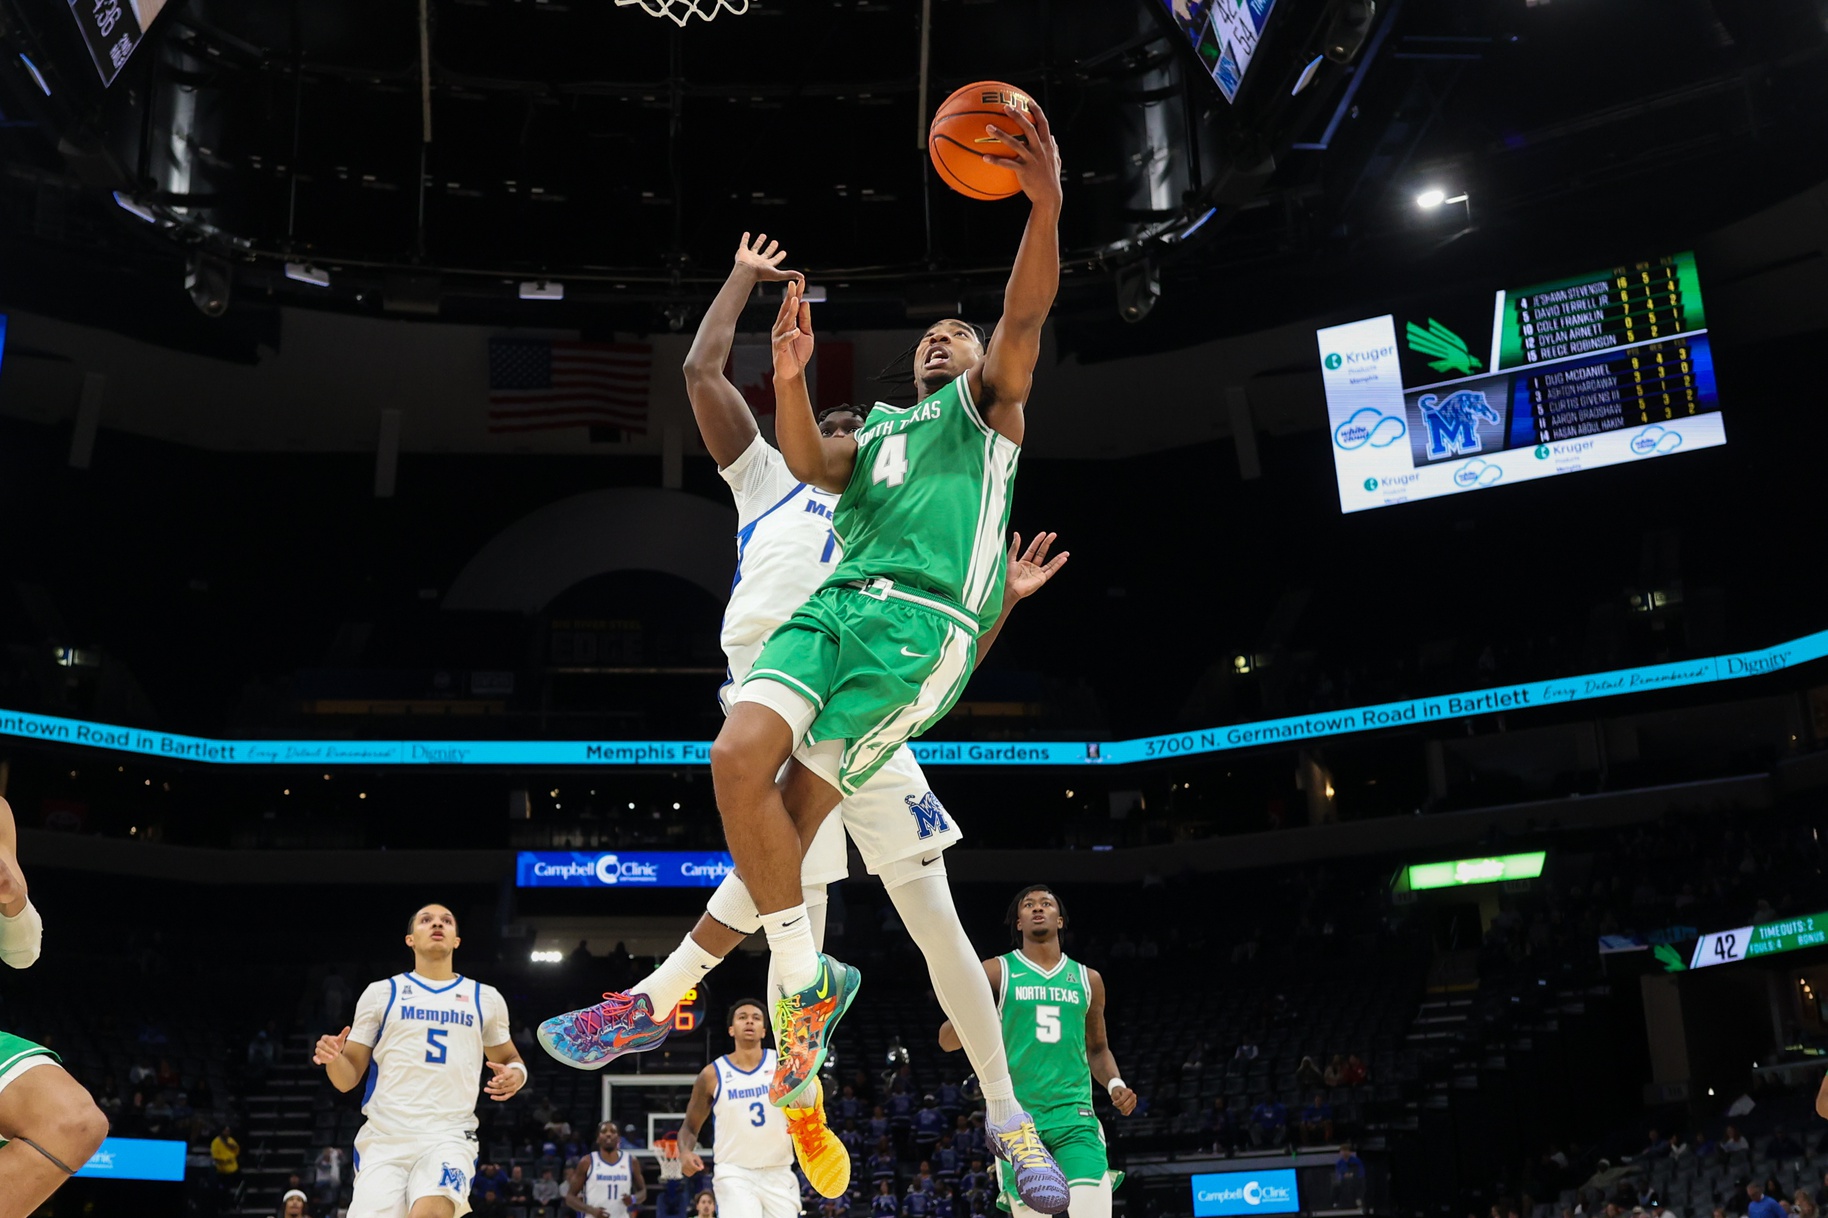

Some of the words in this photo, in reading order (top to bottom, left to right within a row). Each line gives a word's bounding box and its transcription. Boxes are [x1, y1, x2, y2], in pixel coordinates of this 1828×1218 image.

[1233, 17, 1257, 56] 54
[1534, 303, 1560, 320] DAVID
[1562, 297, 1597, 315] TERRELL
[1537, 317, 1559, 333] COLE
[1561, 310, 1604, 329] FRANKLIN
[1539, 330, 1567, 347] DYLAN
[1569, 323, 1602, 341] ARNETT
[1346, 345, 1394, 364] Kruger
[1541, 343, 1568, 359] REECE
[1570, 334, 1616, 356] ROBINSON
[1545, 371, 1564, 387] DUG
[1565, 364, 1610, 383] MCDANIEL
[1549, 397, 1580, 413] CURTIS
[1551, 411, 1578, 426] AARON
[1553, 441, 1594, 456] Kruger
[872, 433, 909, 489] 4
[1381, 472, 1420, 487] Kruger
[820, 527, 836, 563] 1
[1543, 685, 1577, 700] Every
[1584, 678, 1625, 694] Detail
[1145, 736, 1194, 757] 3700
[1201, 733, 1220, 748] N.
[1227, 715, 1356, 745] Germantown
[1362, 703, 1416, 726] Road
[1422, 702, 1441, 717] in
[1449, 688, 1530, 714] Bartlett
[0, 715, 69, 738] ntown
[77, 725, 130, 747] Road
[136, 733, 153, 749] in
[160, 737, 235, 759] Bartlett
[586, 745, 675, 764] Memphis
[968, 744, 1049, 760] Gardens
[534, 861, 594, 880] Campbell
[621, 861, 657, 877] Clinic
[1807, 917, 1814, 931] 2
[1714, 934, 1738, 960] 42
[1015, 986, 1046, 1001] NORTH
[1049, 986, 1080, 1004] TEXAS
[401, 1005, 474, 1027] Memphis
[1035, 1004, 1062, 1043] 5
[425, 1028, 448, 1064] 5
[728, 1084, 769, 1101] Memph
[749, 1101, 766, 1127] 3
[596, 1174, 628, 1182] Memphis
[607, 1184, 618, 1200] 11
[1198, 1187, 1243, 1203] Campbell
[1262, 1186, 1290, 1198] Clinic
